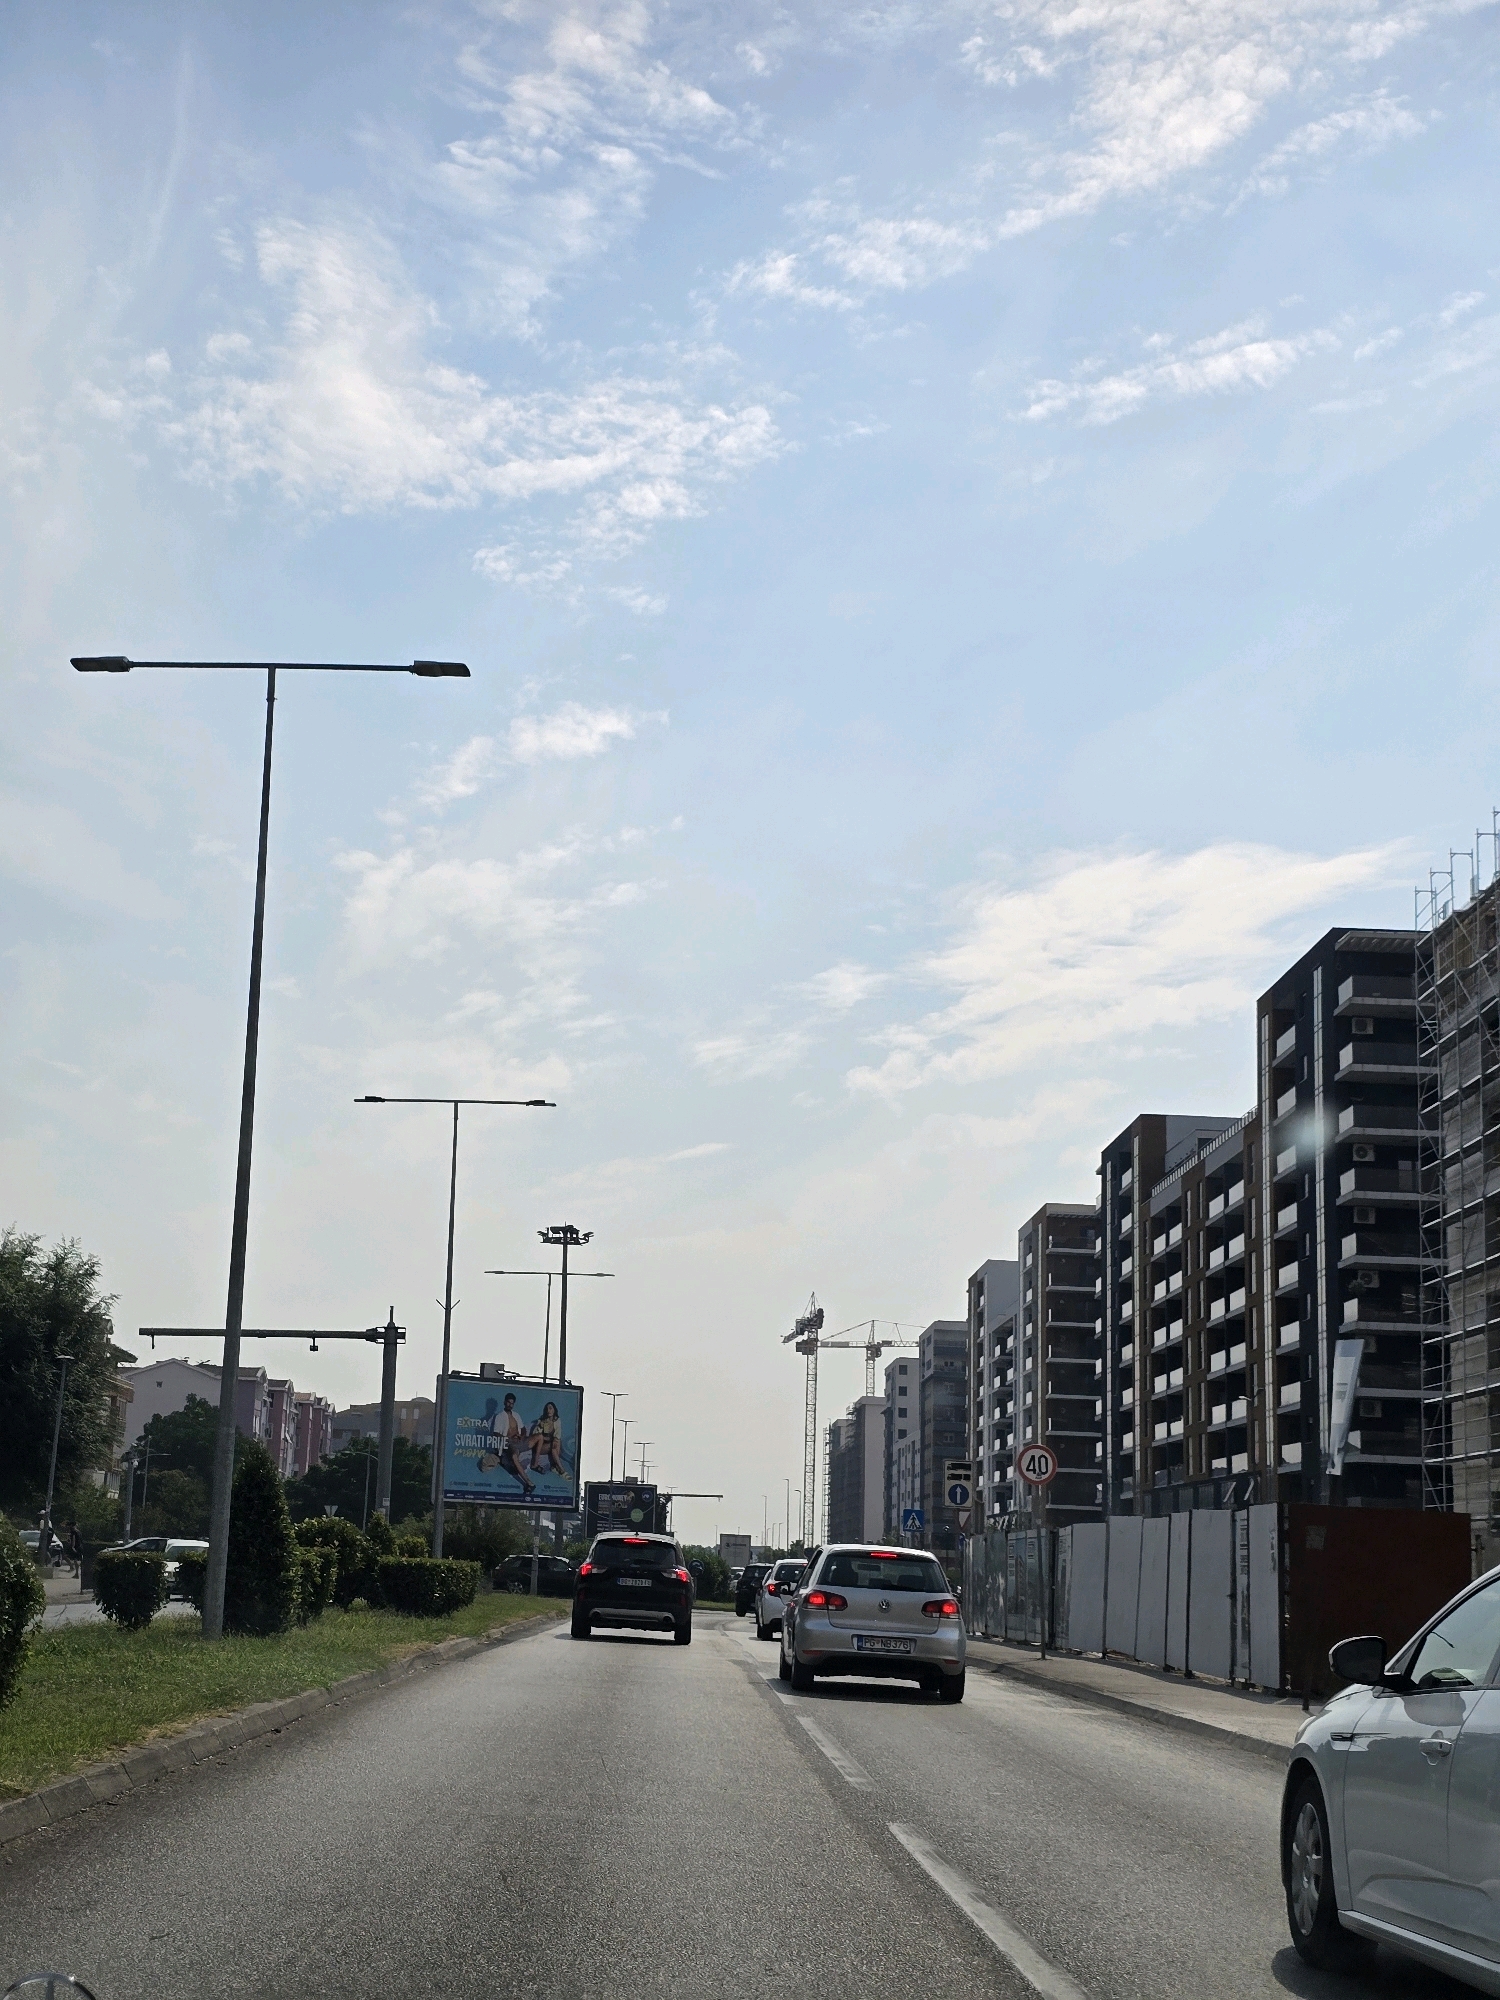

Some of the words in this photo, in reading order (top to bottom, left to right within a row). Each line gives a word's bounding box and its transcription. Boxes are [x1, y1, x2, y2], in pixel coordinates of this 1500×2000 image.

[456, 1417, 489, 1428] EXTRA
[455, 1433, 485, 1448] SVRATI
[486, 1435, 509, 1457] PRIJE
[1026, 1453, 1049, 1475] 40
